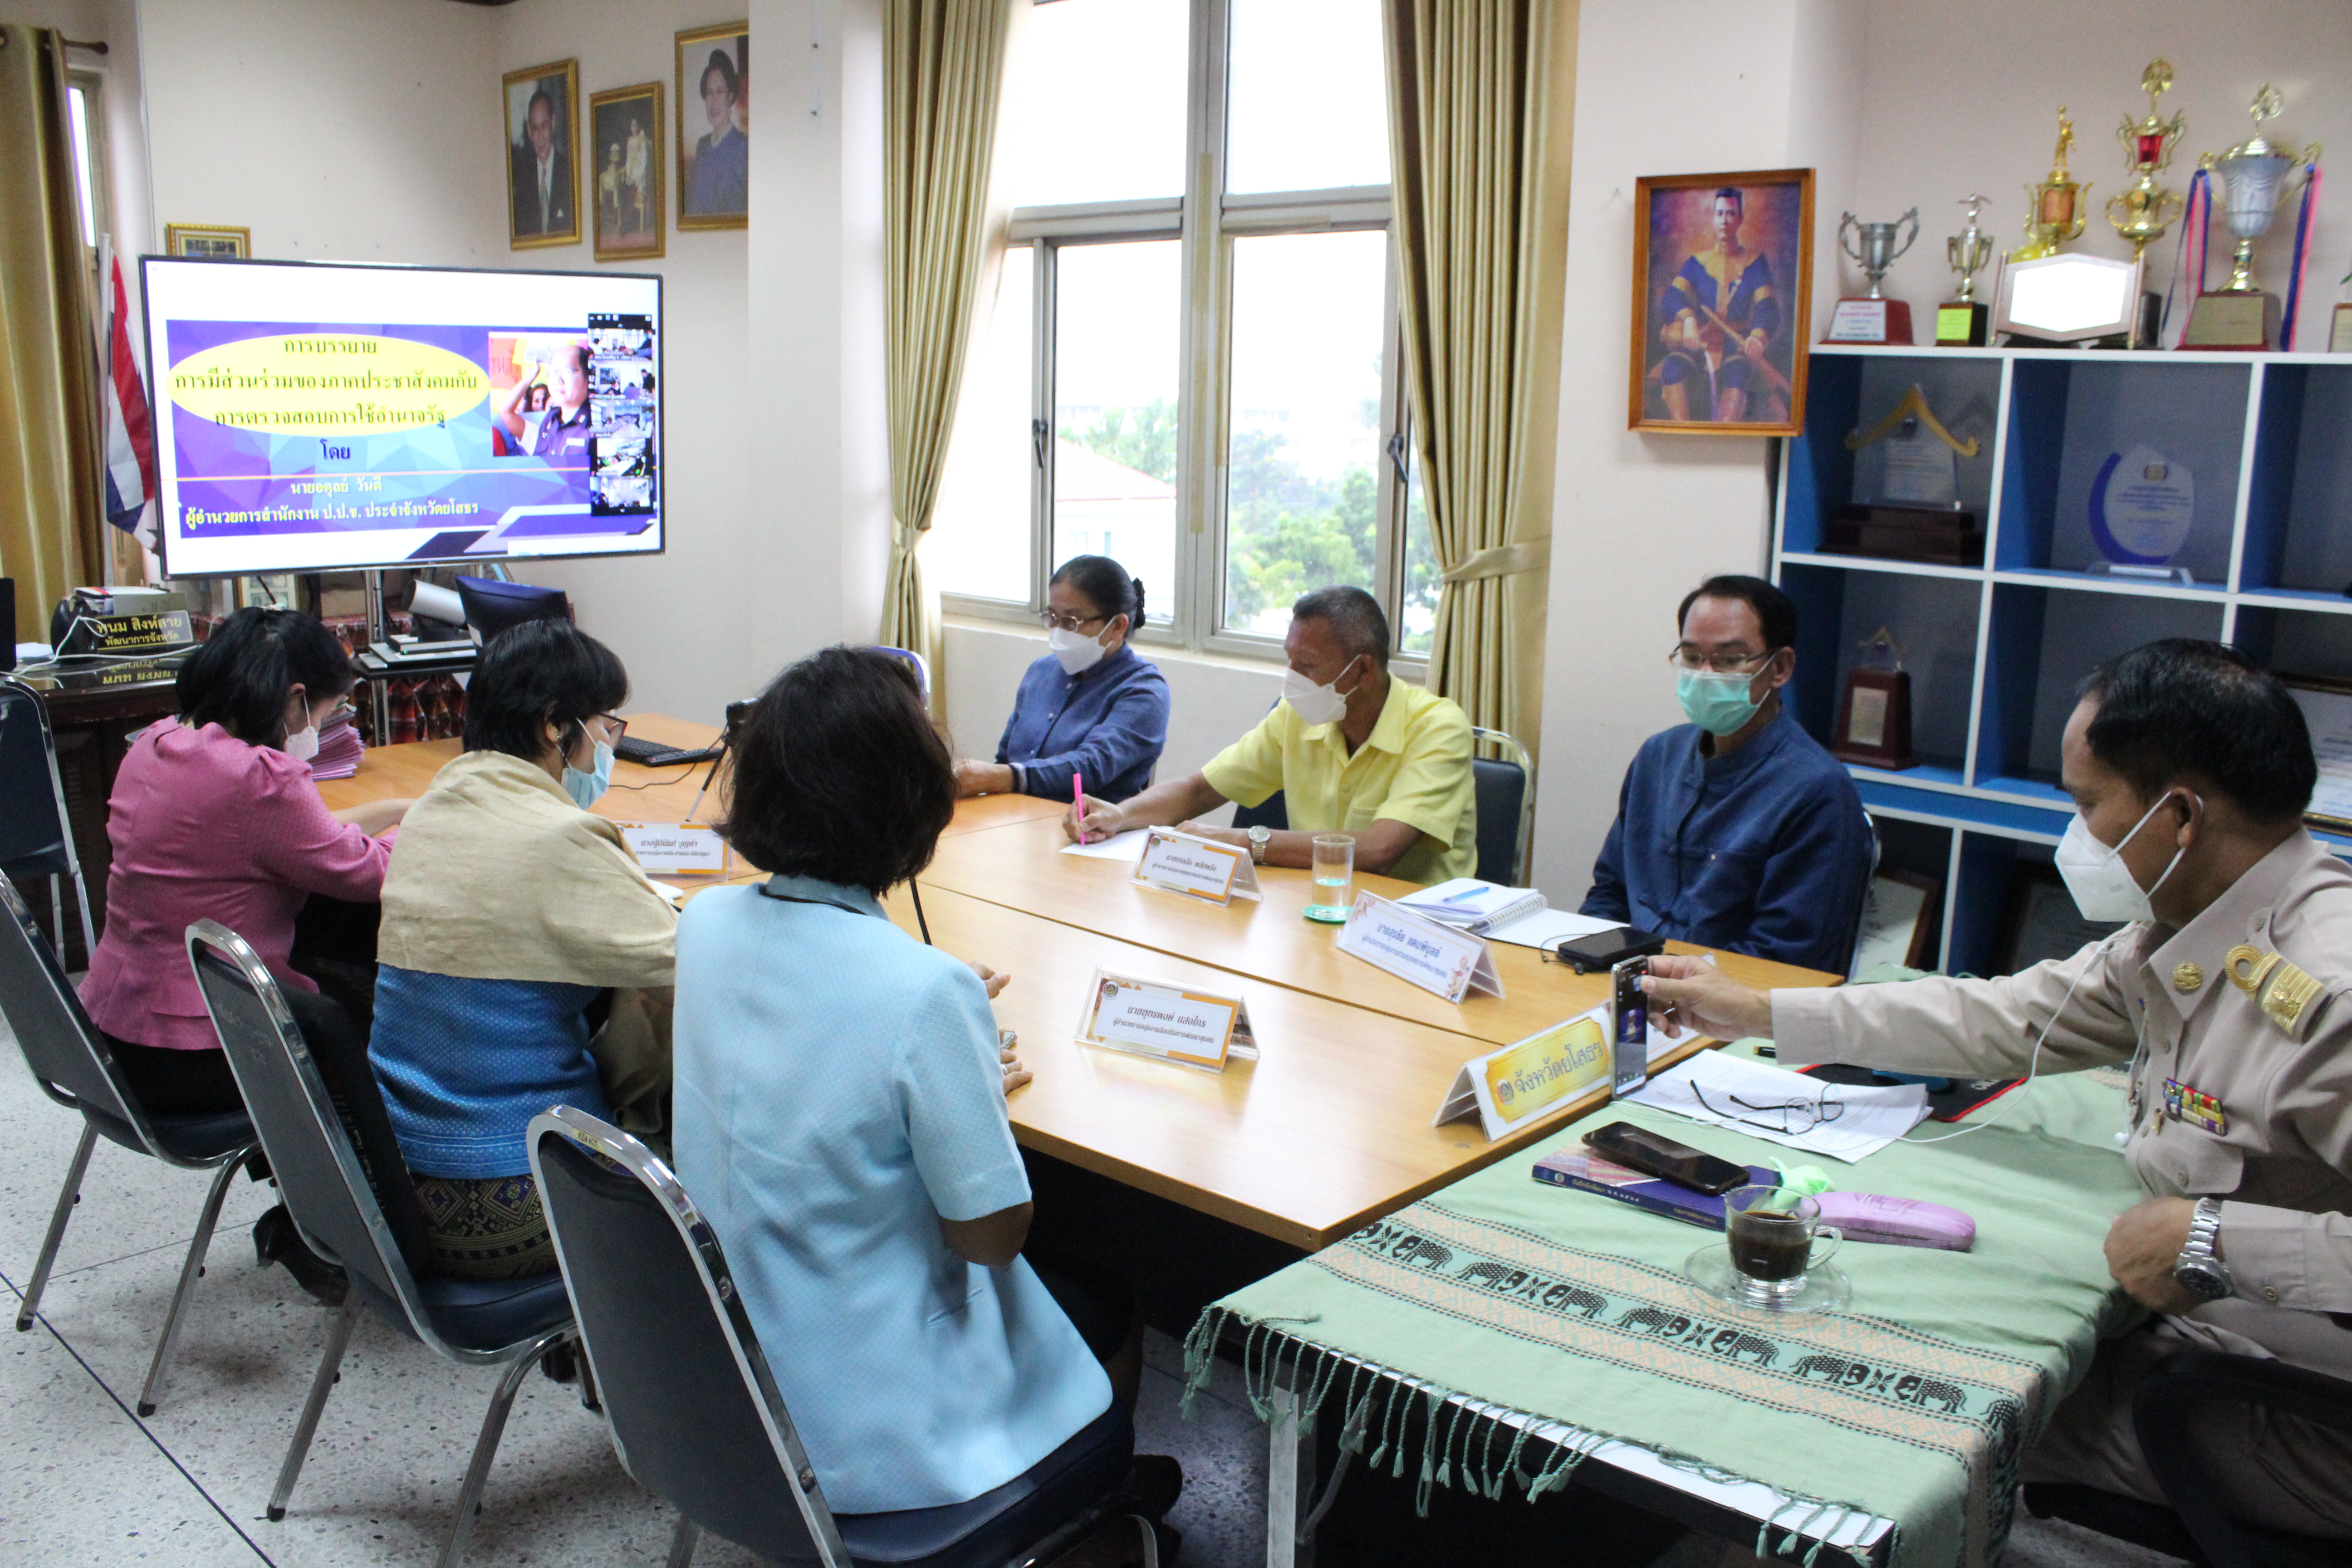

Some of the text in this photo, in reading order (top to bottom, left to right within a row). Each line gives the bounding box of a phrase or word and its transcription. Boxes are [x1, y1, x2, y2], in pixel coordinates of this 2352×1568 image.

[284, 338, 377, 354] การบรรยาย
[175, 368, 478, 389] การมีส่วนร่วมของภาคประชาสังคมกับ
[215, 402, 446, 428] การตรวจสอบการใช้อำนาจรัฐ
[319, 438, 351, 459] โดย
[290, 475, 382, 498] นายอดุลย์ วันดี
[186, 498, 479, 530] ผู้อำนวยการสำนักงาน ป.ป.ช. ประจำจังหวัดยโสธร
[1514, 1042, 1603, 1094] จังหวัดยโสธร
